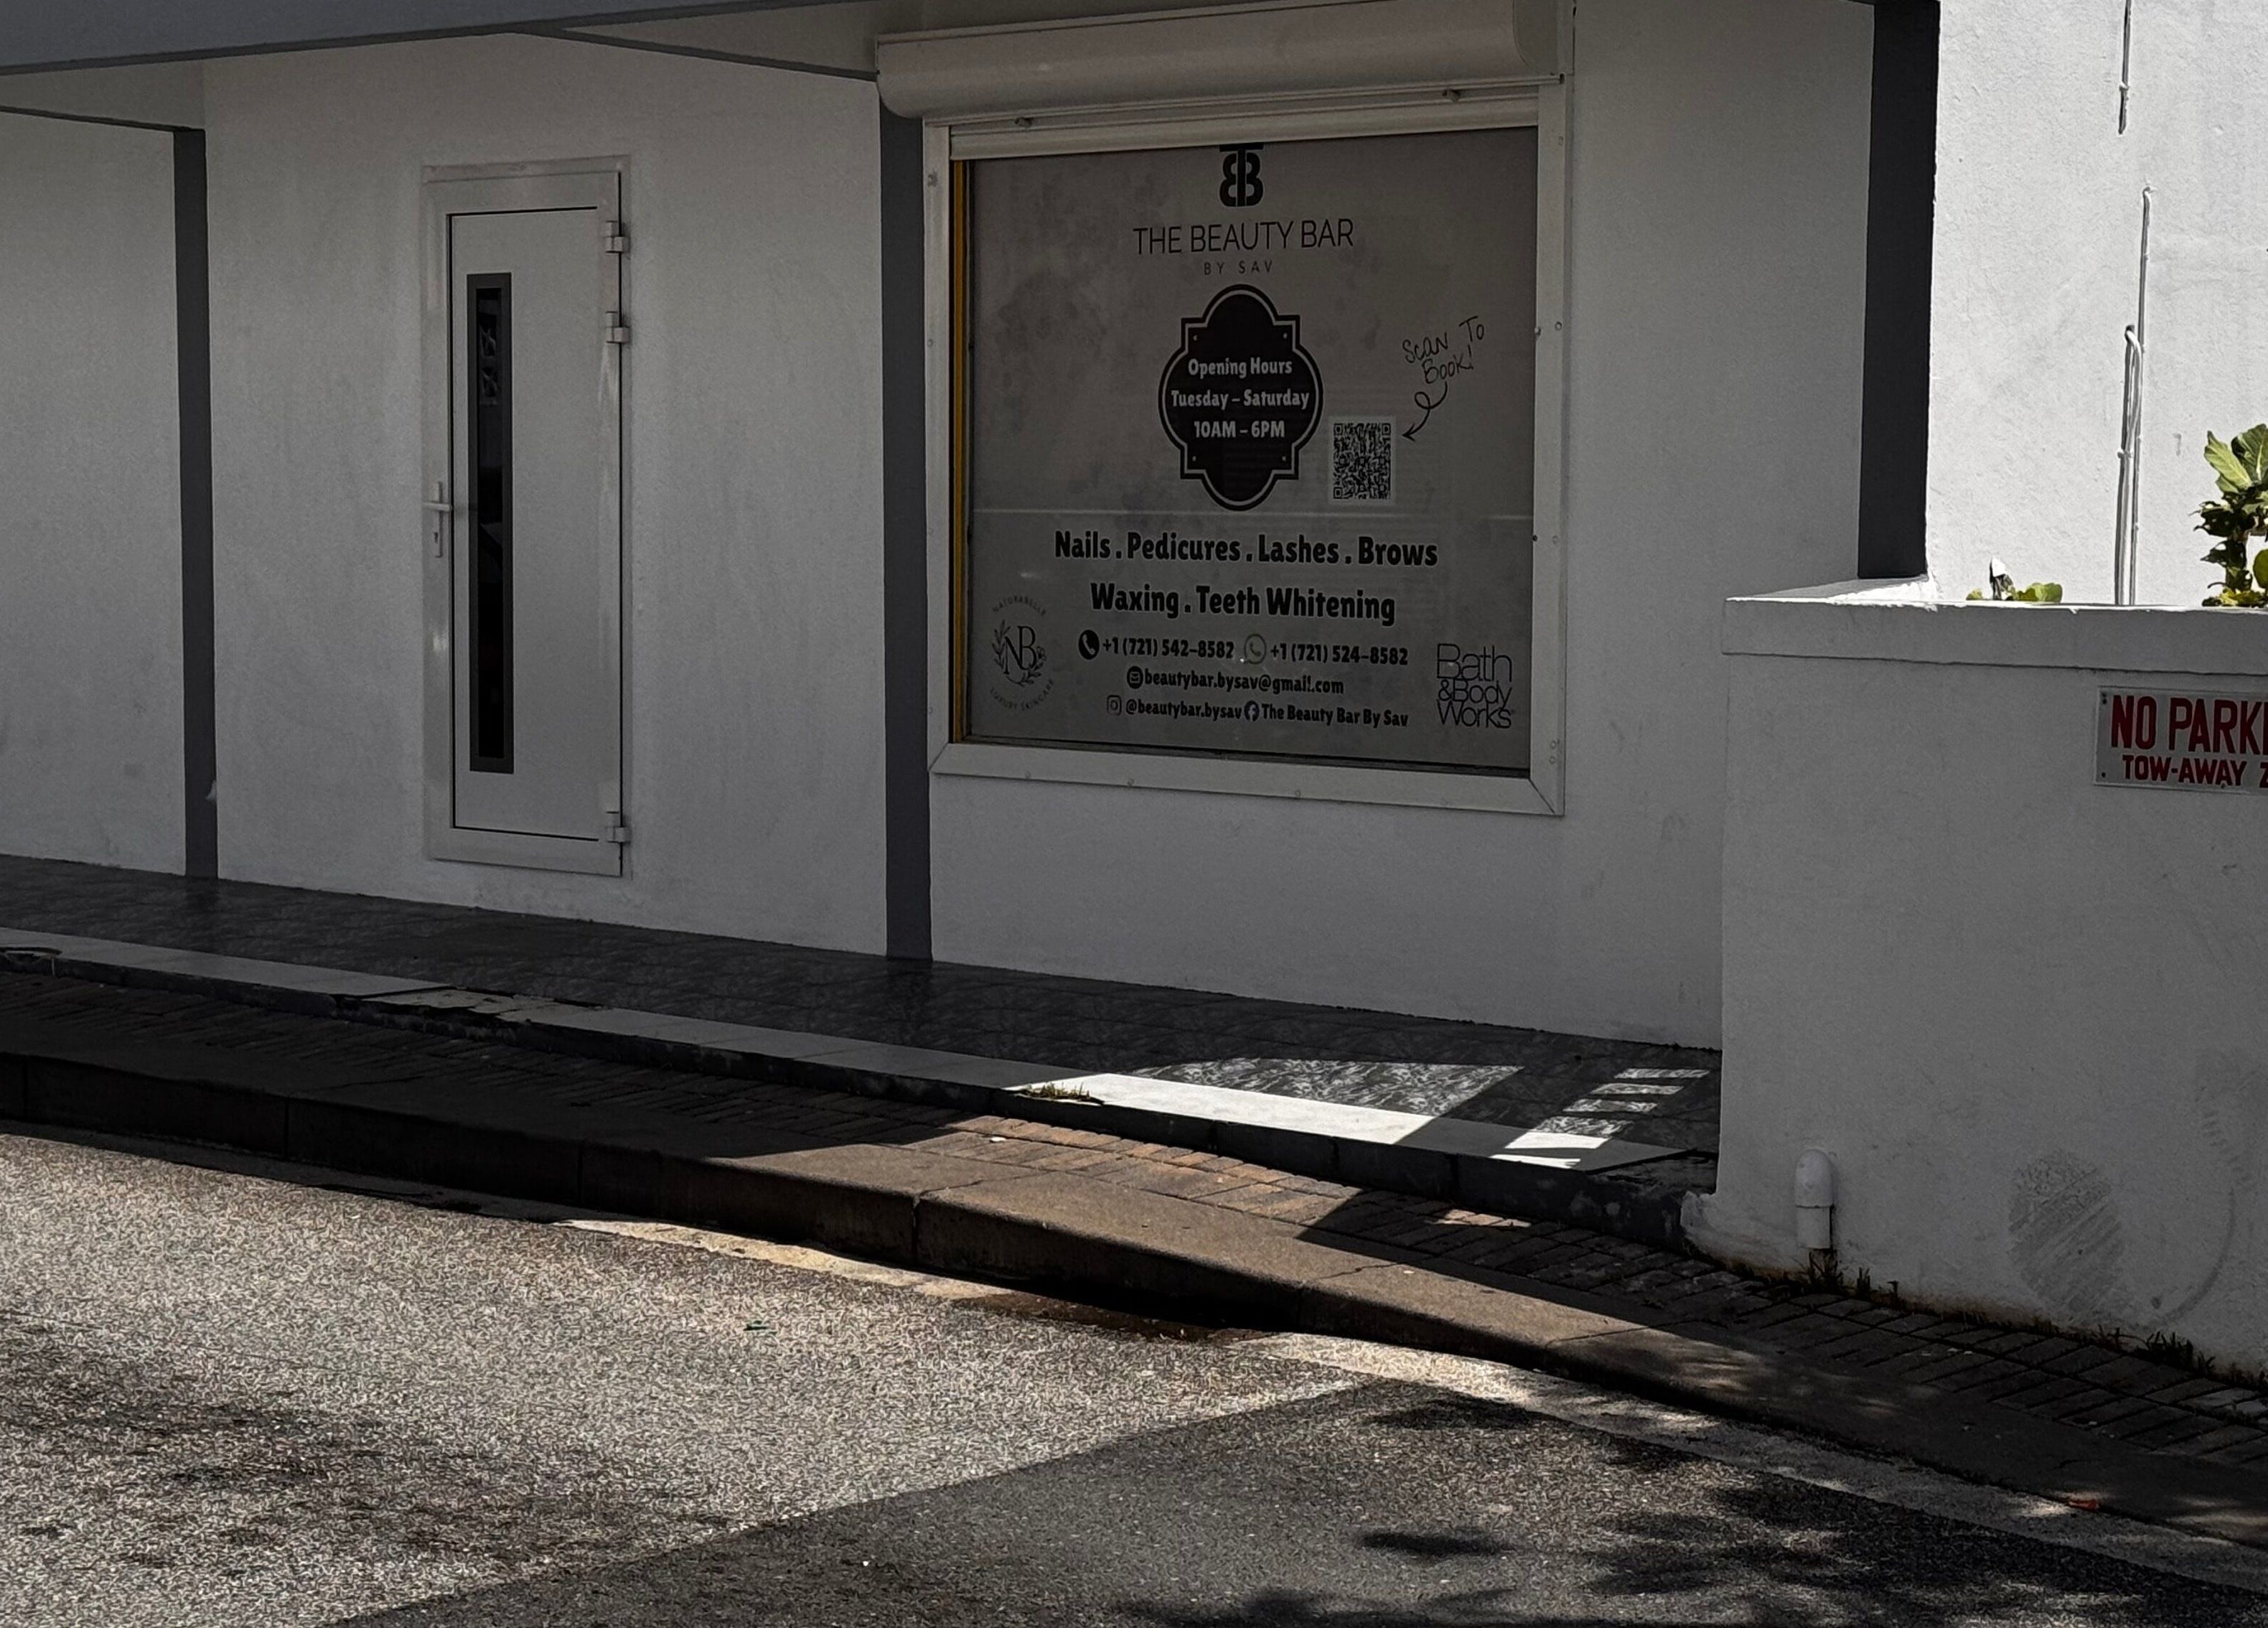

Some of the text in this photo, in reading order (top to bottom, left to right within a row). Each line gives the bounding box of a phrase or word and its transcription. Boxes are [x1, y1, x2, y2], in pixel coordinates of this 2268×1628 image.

[1133, 217, 1354, 255] THE BEAUTY BAR
[1203, 259, 1273, 276] BY SAV
[1188, 356, 1293, 379] Opening Hours
[1171, 389, 1229, 410] Tuesday
[1243, 388, 1310, 410] Saturday
[1194, 421, 1236, 439] 10AM
[1251, 420, 1285, 439] 6PM
[1054, 530, 1110, 558] Nails
[1128, 532, 1241, 561] Pedicures
[1259, 534, 1339, 564] Lashes
[1358, 535, 1438, 566] Brows
[1090, 582, 1179, 619] Waxing
[1196, 585, 1260, 614] Teeth
[1267, 587, 1395, 626] Whitening
[1102, 637, 1234, 659] +1 (721) 542-8582
[1270, 643, 1409, 665] +1 (721) 524-8582
[1436, 642, 1512, 683] Bath
[1125, 698, 1242, 721] @beautybar.bysav
[1261, 703, 1409, 729] The Beauty Bar By Sav
[1436, 698, 1512, 729] Works
[2111, 695, 2157, 749] NO
[2122, 754, 2247, 786] TOW-AWAY
